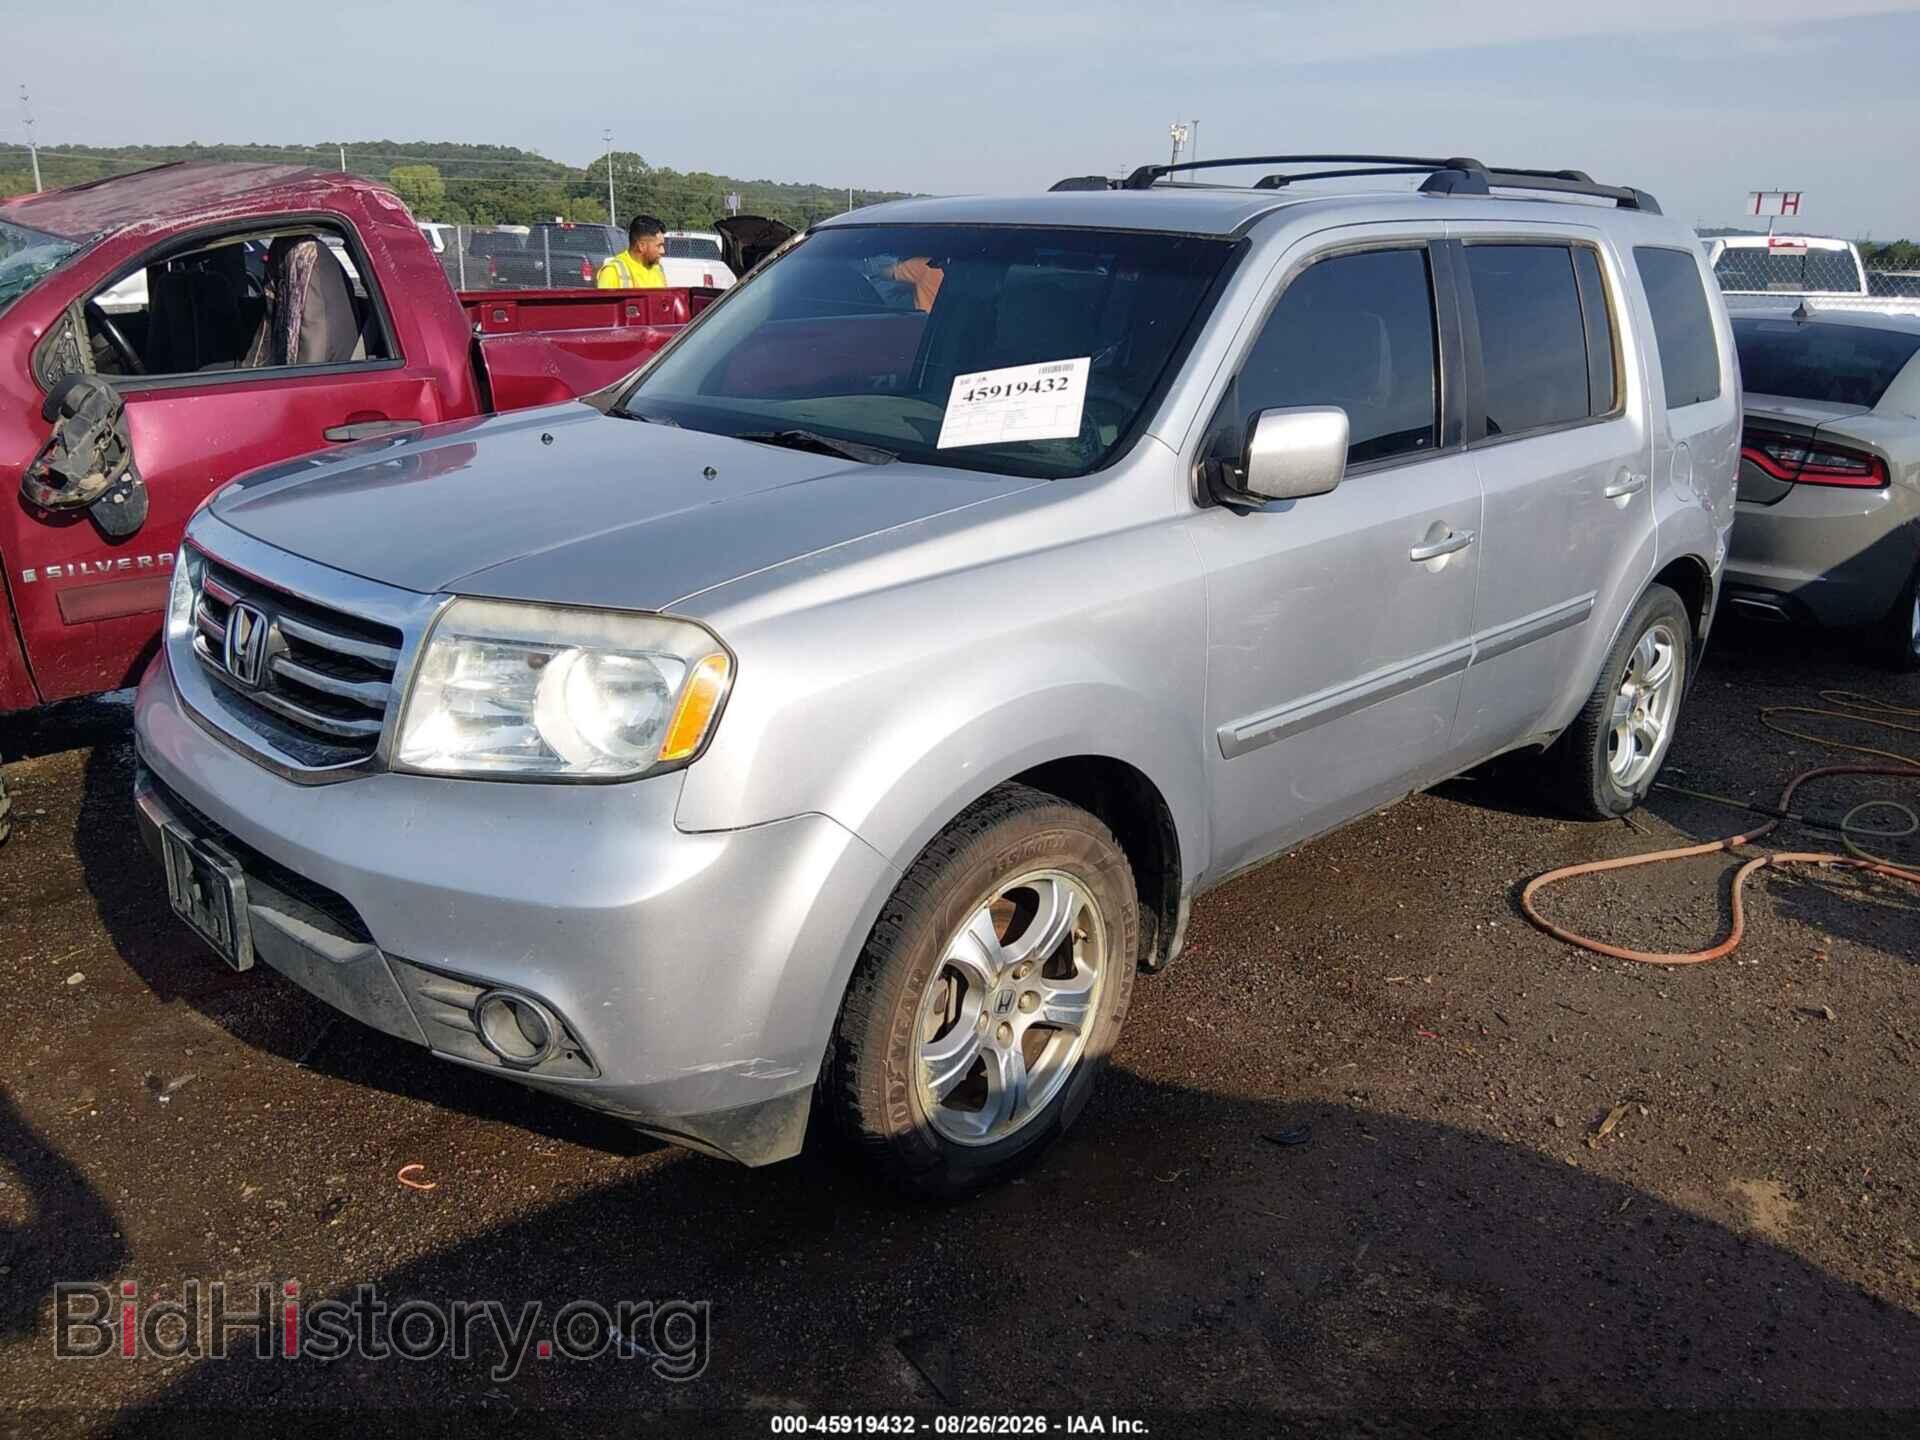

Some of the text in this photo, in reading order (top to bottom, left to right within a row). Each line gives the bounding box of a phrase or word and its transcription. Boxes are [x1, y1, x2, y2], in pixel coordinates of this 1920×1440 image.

[1780, 192, 1801, 215] H
[962, 376, 1070, 402] 45919432
[46, 552, 175, 579] SILVERA
